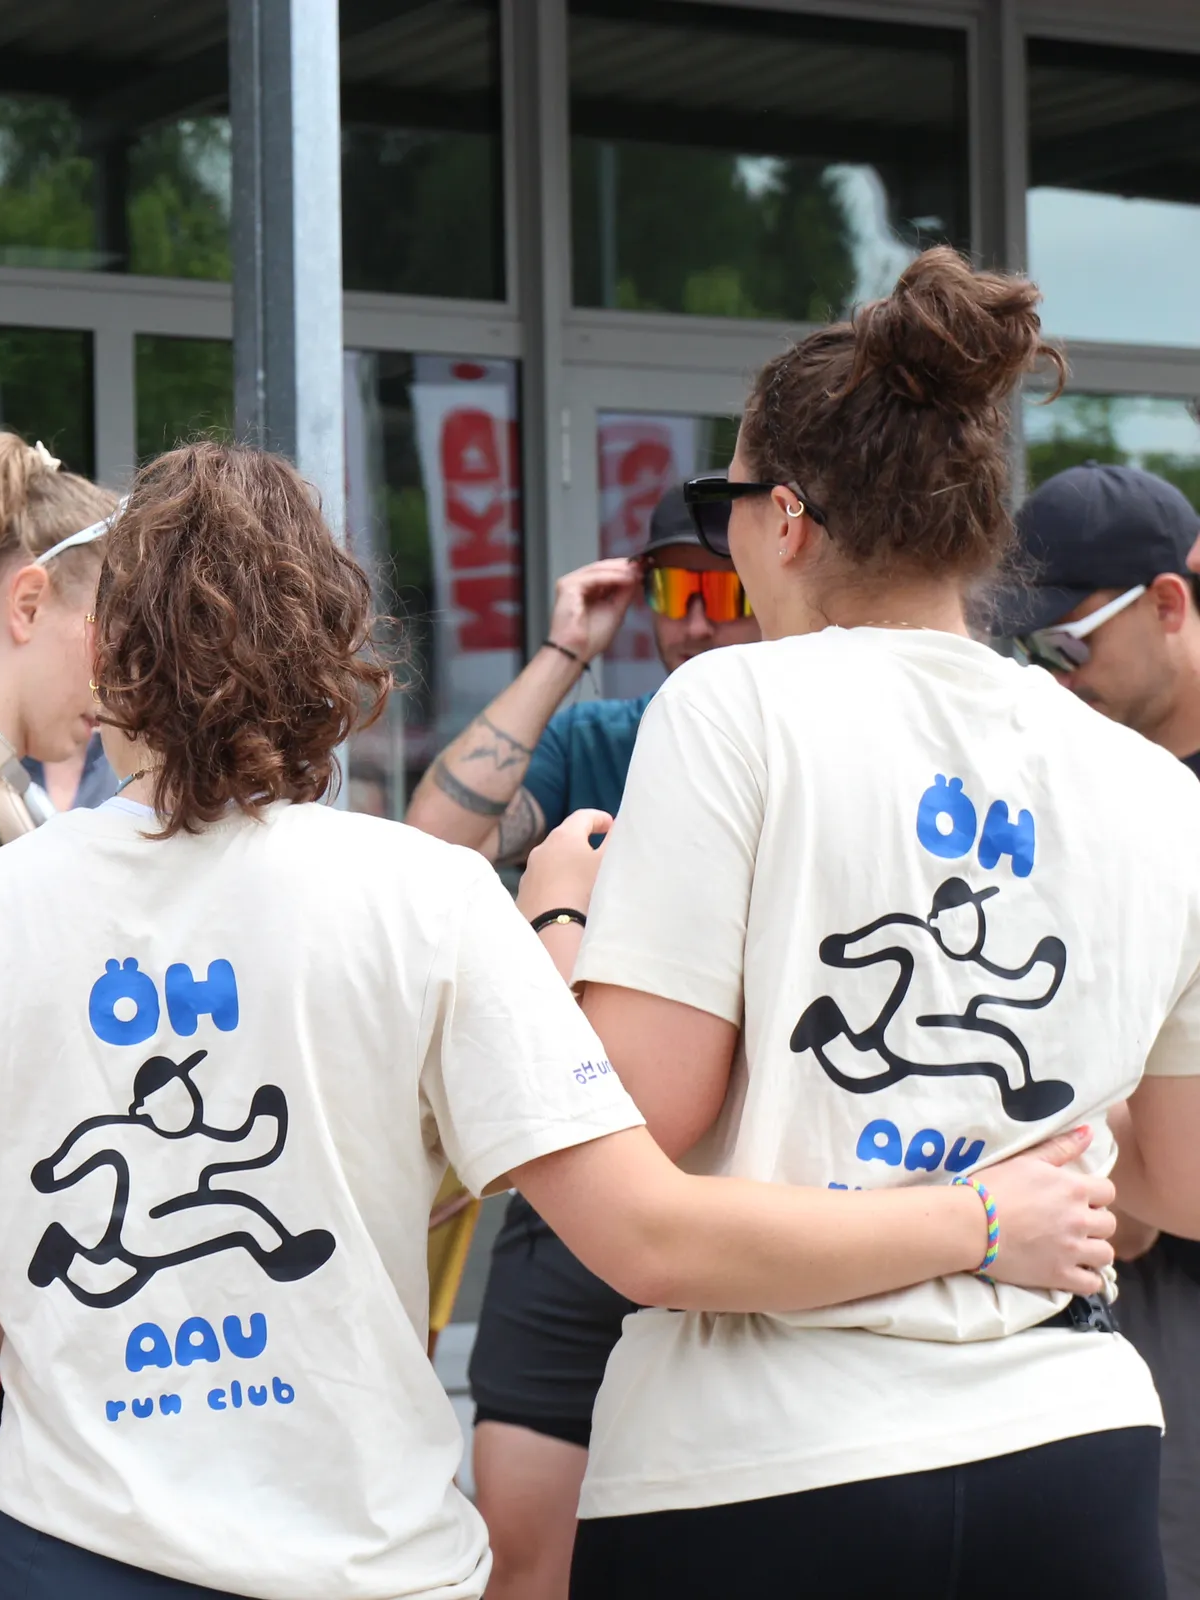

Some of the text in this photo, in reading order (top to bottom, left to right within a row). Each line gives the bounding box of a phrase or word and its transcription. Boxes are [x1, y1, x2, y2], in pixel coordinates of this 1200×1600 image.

[917, 774, 1035, 878] ÖH
[89, 957, 239, 1046] ÖH
[856, 1119, 985, 1173] AAU
[125, 1312, 267, 1373] AAU
[106, 1376, 295, 1422] run club
